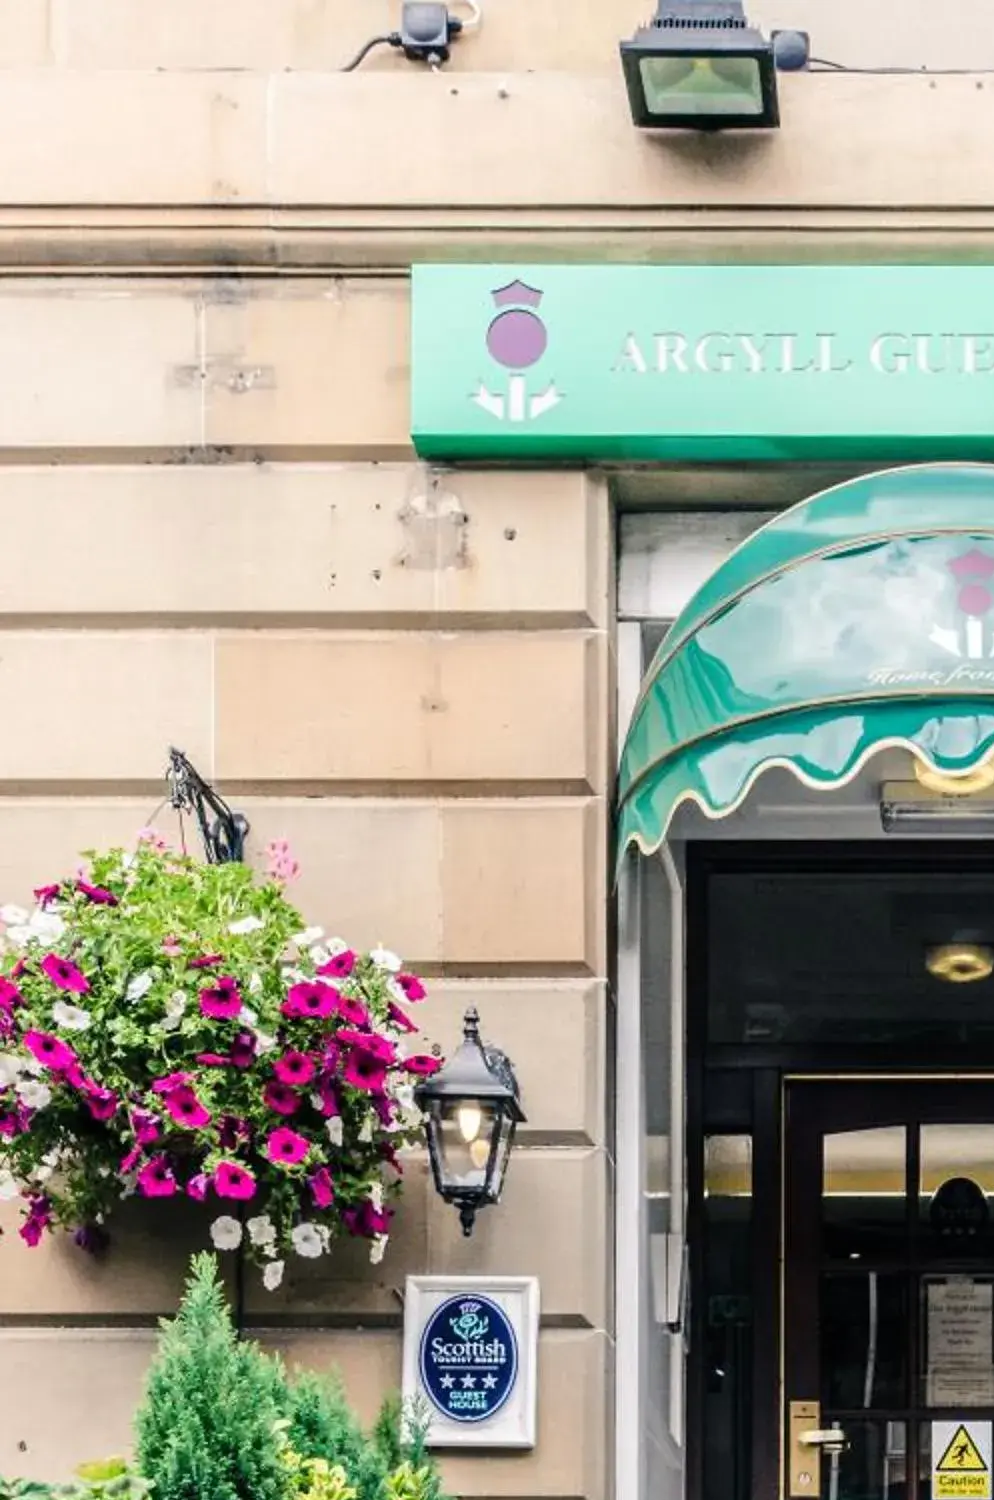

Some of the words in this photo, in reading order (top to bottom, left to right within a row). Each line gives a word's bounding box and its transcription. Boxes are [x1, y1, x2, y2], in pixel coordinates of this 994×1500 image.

[609, 331, 853, 374] ARGYLL
[866, 667, 944, 686] Home
[431, 1337, 506, 1357] Scottish
[449, 1391, 487, 1400] GUEST
[449, 1400, 488, 1409] HOUSE
[939, 1475, 985, 1486] Caution
